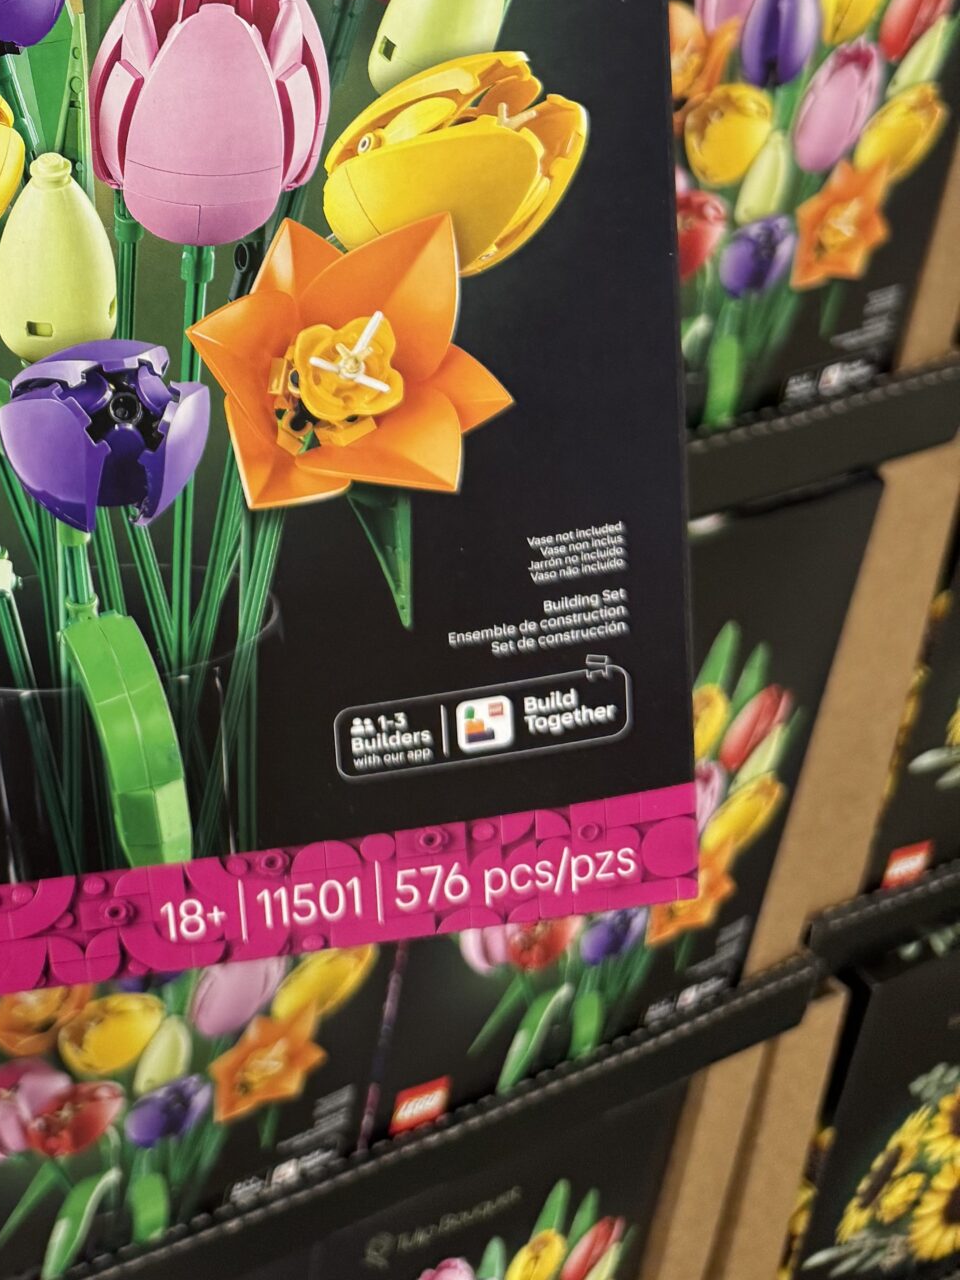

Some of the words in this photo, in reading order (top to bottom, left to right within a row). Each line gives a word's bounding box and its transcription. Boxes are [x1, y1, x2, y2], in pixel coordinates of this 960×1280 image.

[527, 534, 553, 548] Vase
[555, 530, 575, 543] not
[575, 521, 624, 538] included
[540, 544, 566, 558] Vase
[568, 539, 590, 552] non
[591, 534, 624, 548] inclus
[528, 556, 562, 571] Jarrón
[564, 553, 580, 564] no
[530, 570, 558, 584] Vaso
[559, 565, 579, 578] não
[543, 592, 600, 614] Building
[601, 588, 626, 604] Set
[448, 622, 517, 646] Ensemble
[518, 619, 537, 634] de
[539, 604, 626, 631] construction
[491, 639, 516, 655] Set
[517, 636, 536, 650] de
[538, 620, 626, 647] construcción
[524, 688, 577, 713] Build
[376, 711, 408, 732] 1-3
[525, 703, 617, 736] Together
[352, 728, 432, 754] Builders
[353, 753, 382, 769] with
[382, 750, 406, 765] our
[407, 746, 432, 764] app
[159, 898, 227, 942] 18+
[256, 875, 363, 929] 11501
[395, 862, 470, 912] 576
[483, 845, 639, 906] pcs/pzs
